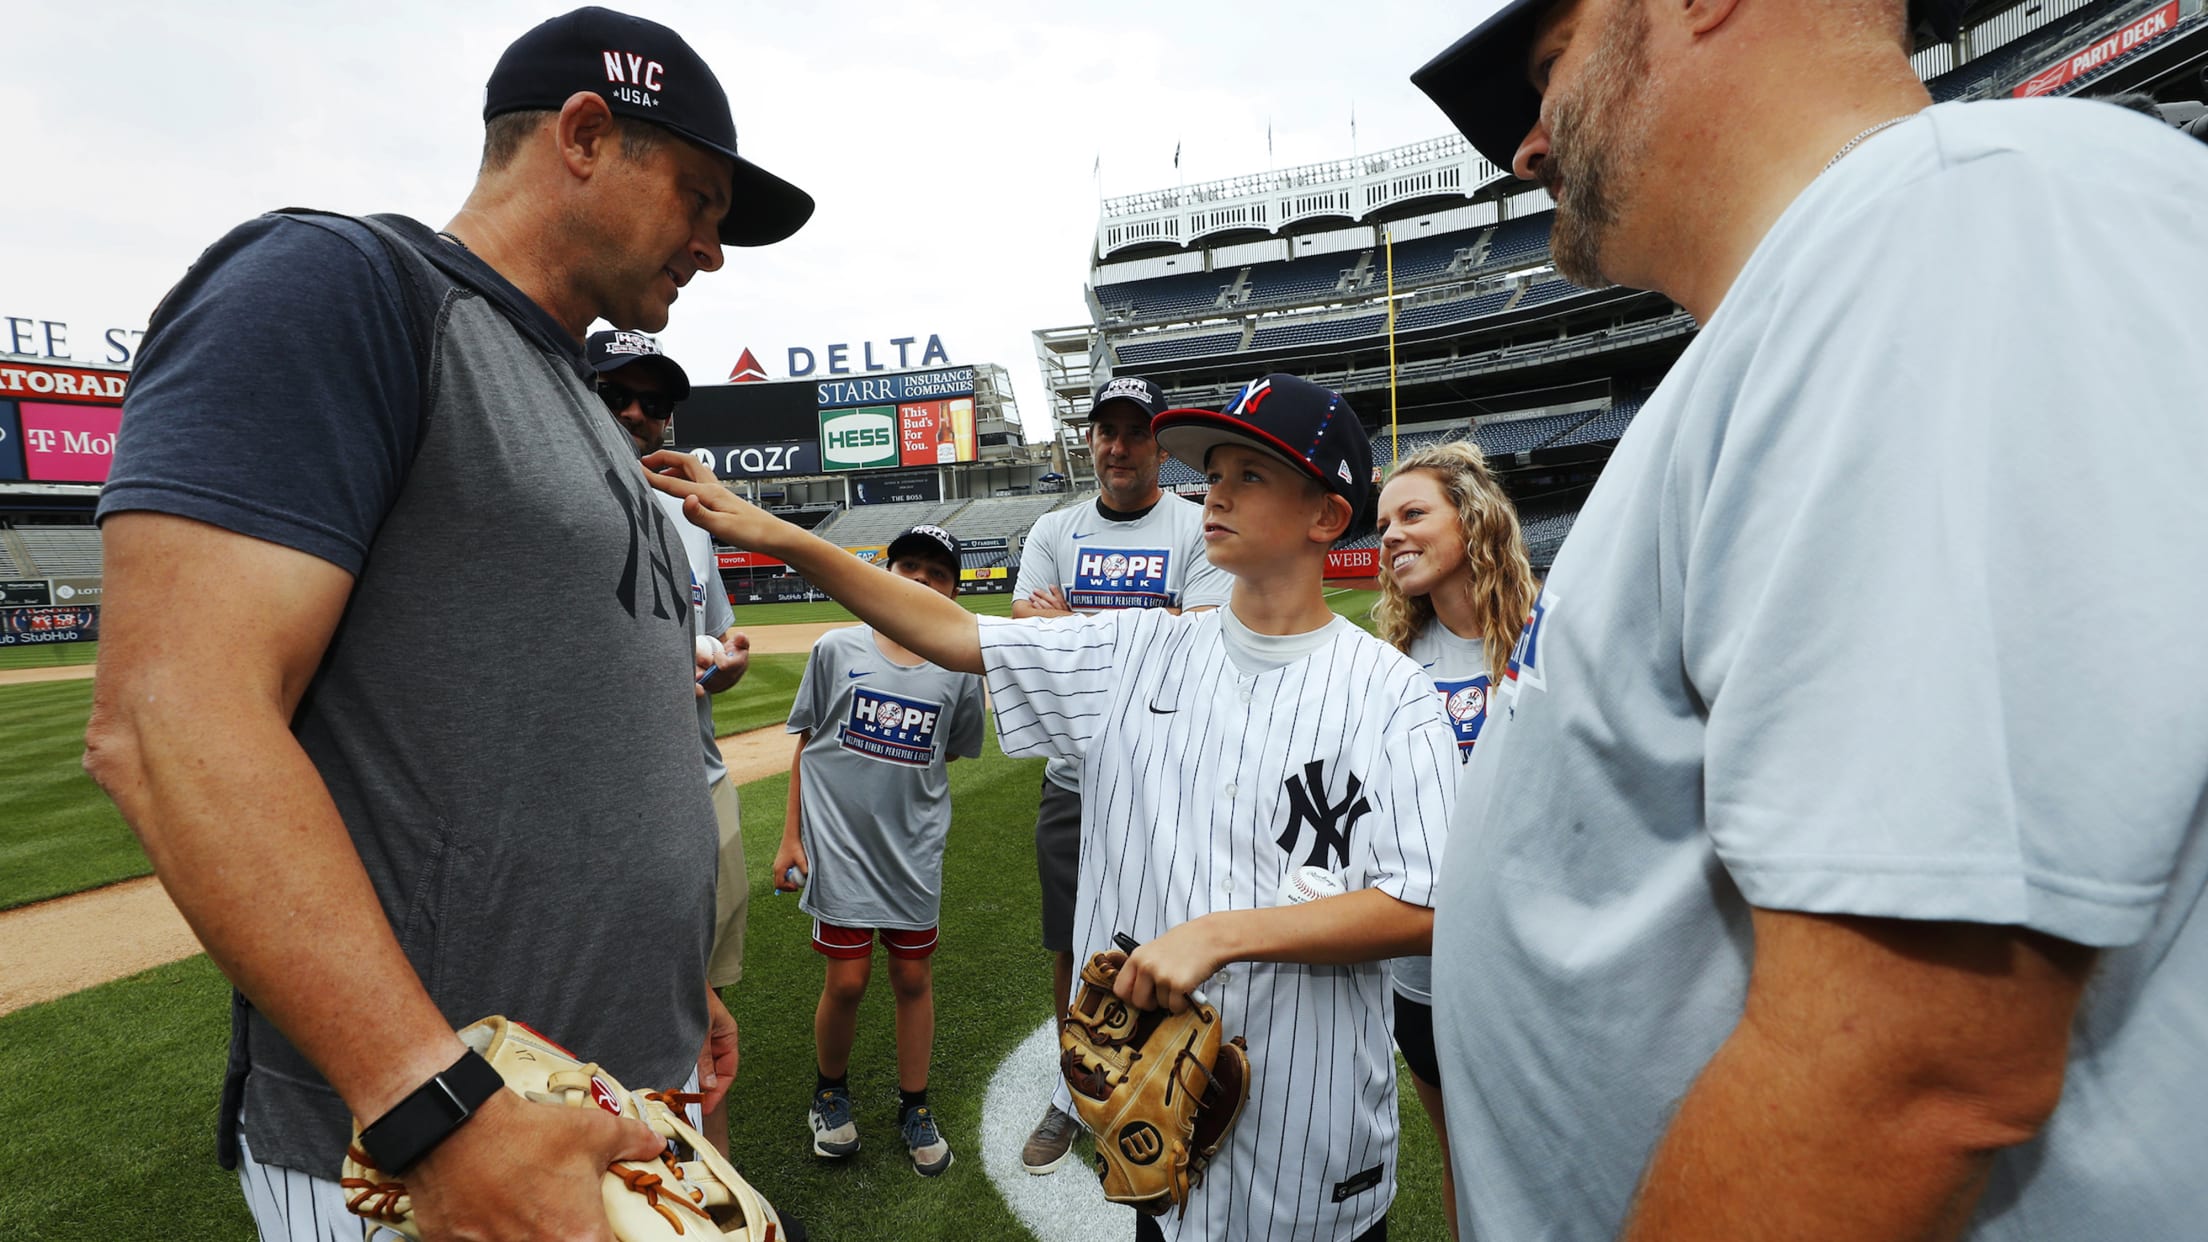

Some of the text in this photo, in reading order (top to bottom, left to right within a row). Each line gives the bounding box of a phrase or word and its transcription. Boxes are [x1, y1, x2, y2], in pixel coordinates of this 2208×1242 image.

[2071, 11, 2168, 75] PARTY DECK
[602, 51, 664, 92] NYC
[620, 87, 652, 107] USA
[788, 333, 950, 377] DELTA
[0, 368, 128, 397] TORAD
[904, 369, 973, 387] INSURANCE
[817, 379, 896, 404] STARR
[904, 380, 974, 397] COMPANIES
[902, 407, 927, 418] This
[904, 418, 933, 429] Bud's
[828, 427, 890, 449] HESS
[904, 430, 923, 440] For
[904, 441, 928, 451] You.
[725, 445, 800, 473] razr
[906, 493, 923, 501] BOSS
[1080, 554, 1164, 578] HOPE
[1328, 552, 1372, 567] WEBB
[1090, 579, 1150, 587] WEEK
[1073, 595, 1093, 605] HELPING
[20, 630, 78, 643] StubHub
[855, 697, 936, 734] HOPE
[864, 723, 922, 743] WEEK
[845, 734, 864, 749] HELPING
[885, 746, 913, 760] PERSEVERE
[1276, 759, 1372, 869] NY
